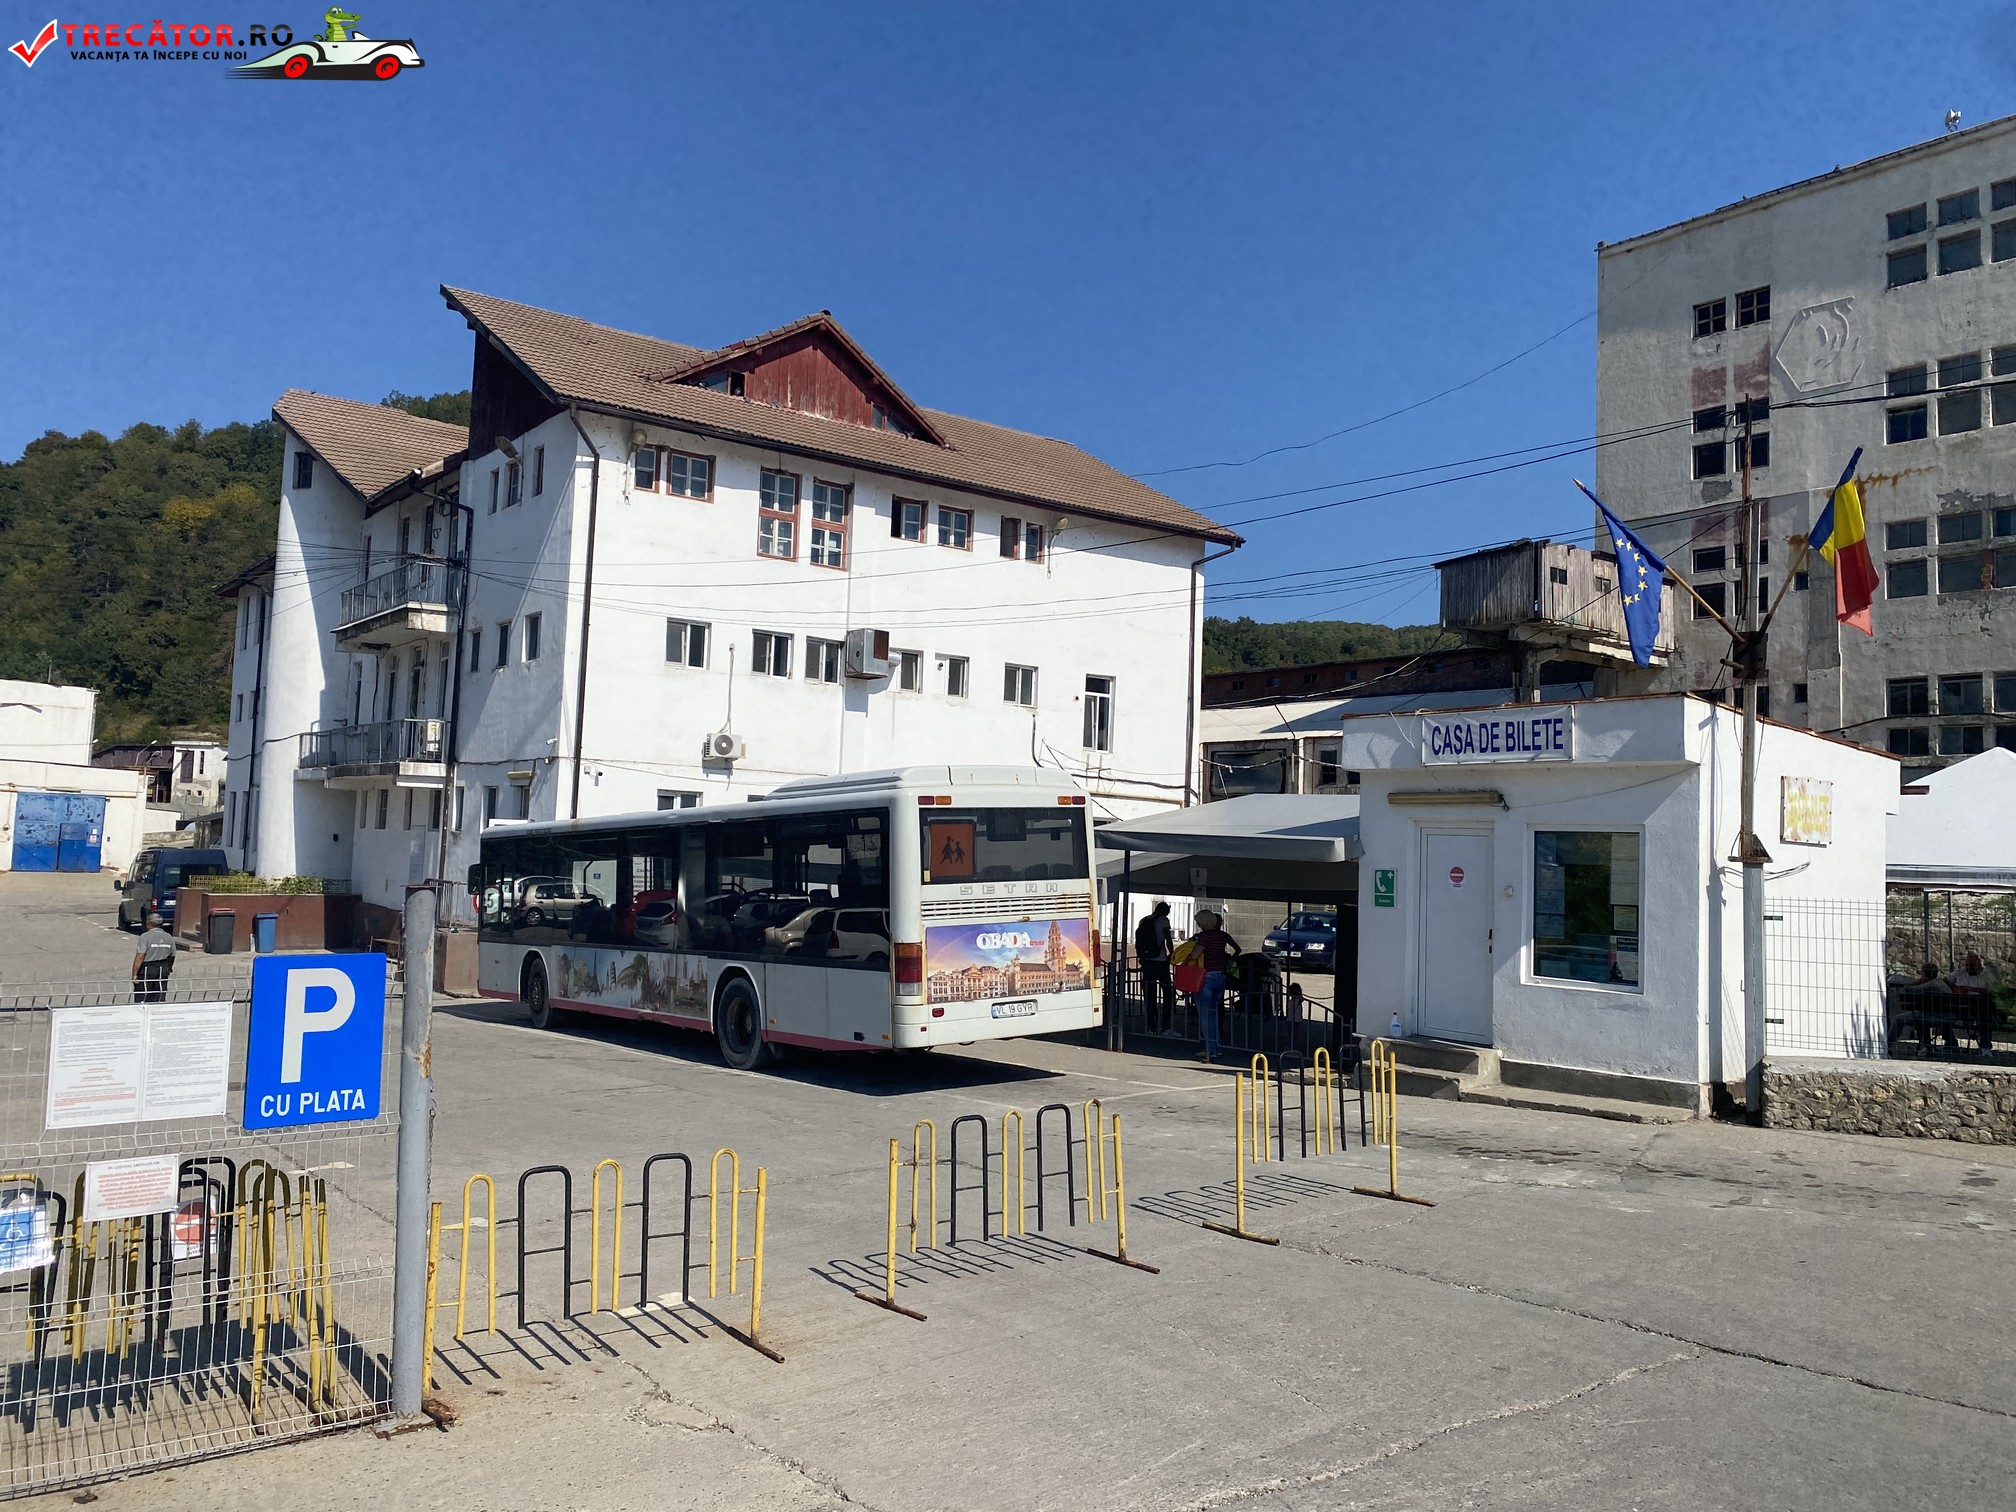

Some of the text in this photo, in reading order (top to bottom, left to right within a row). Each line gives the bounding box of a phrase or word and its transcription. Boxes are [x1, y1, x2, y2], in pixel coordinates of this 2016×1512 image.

[1431, 718, 1564, 755] CASA DE BILETE
[960, 883, 1058, 895] SETRA
[976, 931, 1031, 949] OBADA
[996, 1005, 1006, 1015] VL
[1008, 1004, 1015, 1014] 19
[281, 968, 356, 1083] P
[260, 1089, 365, 1118] CU PLATA
